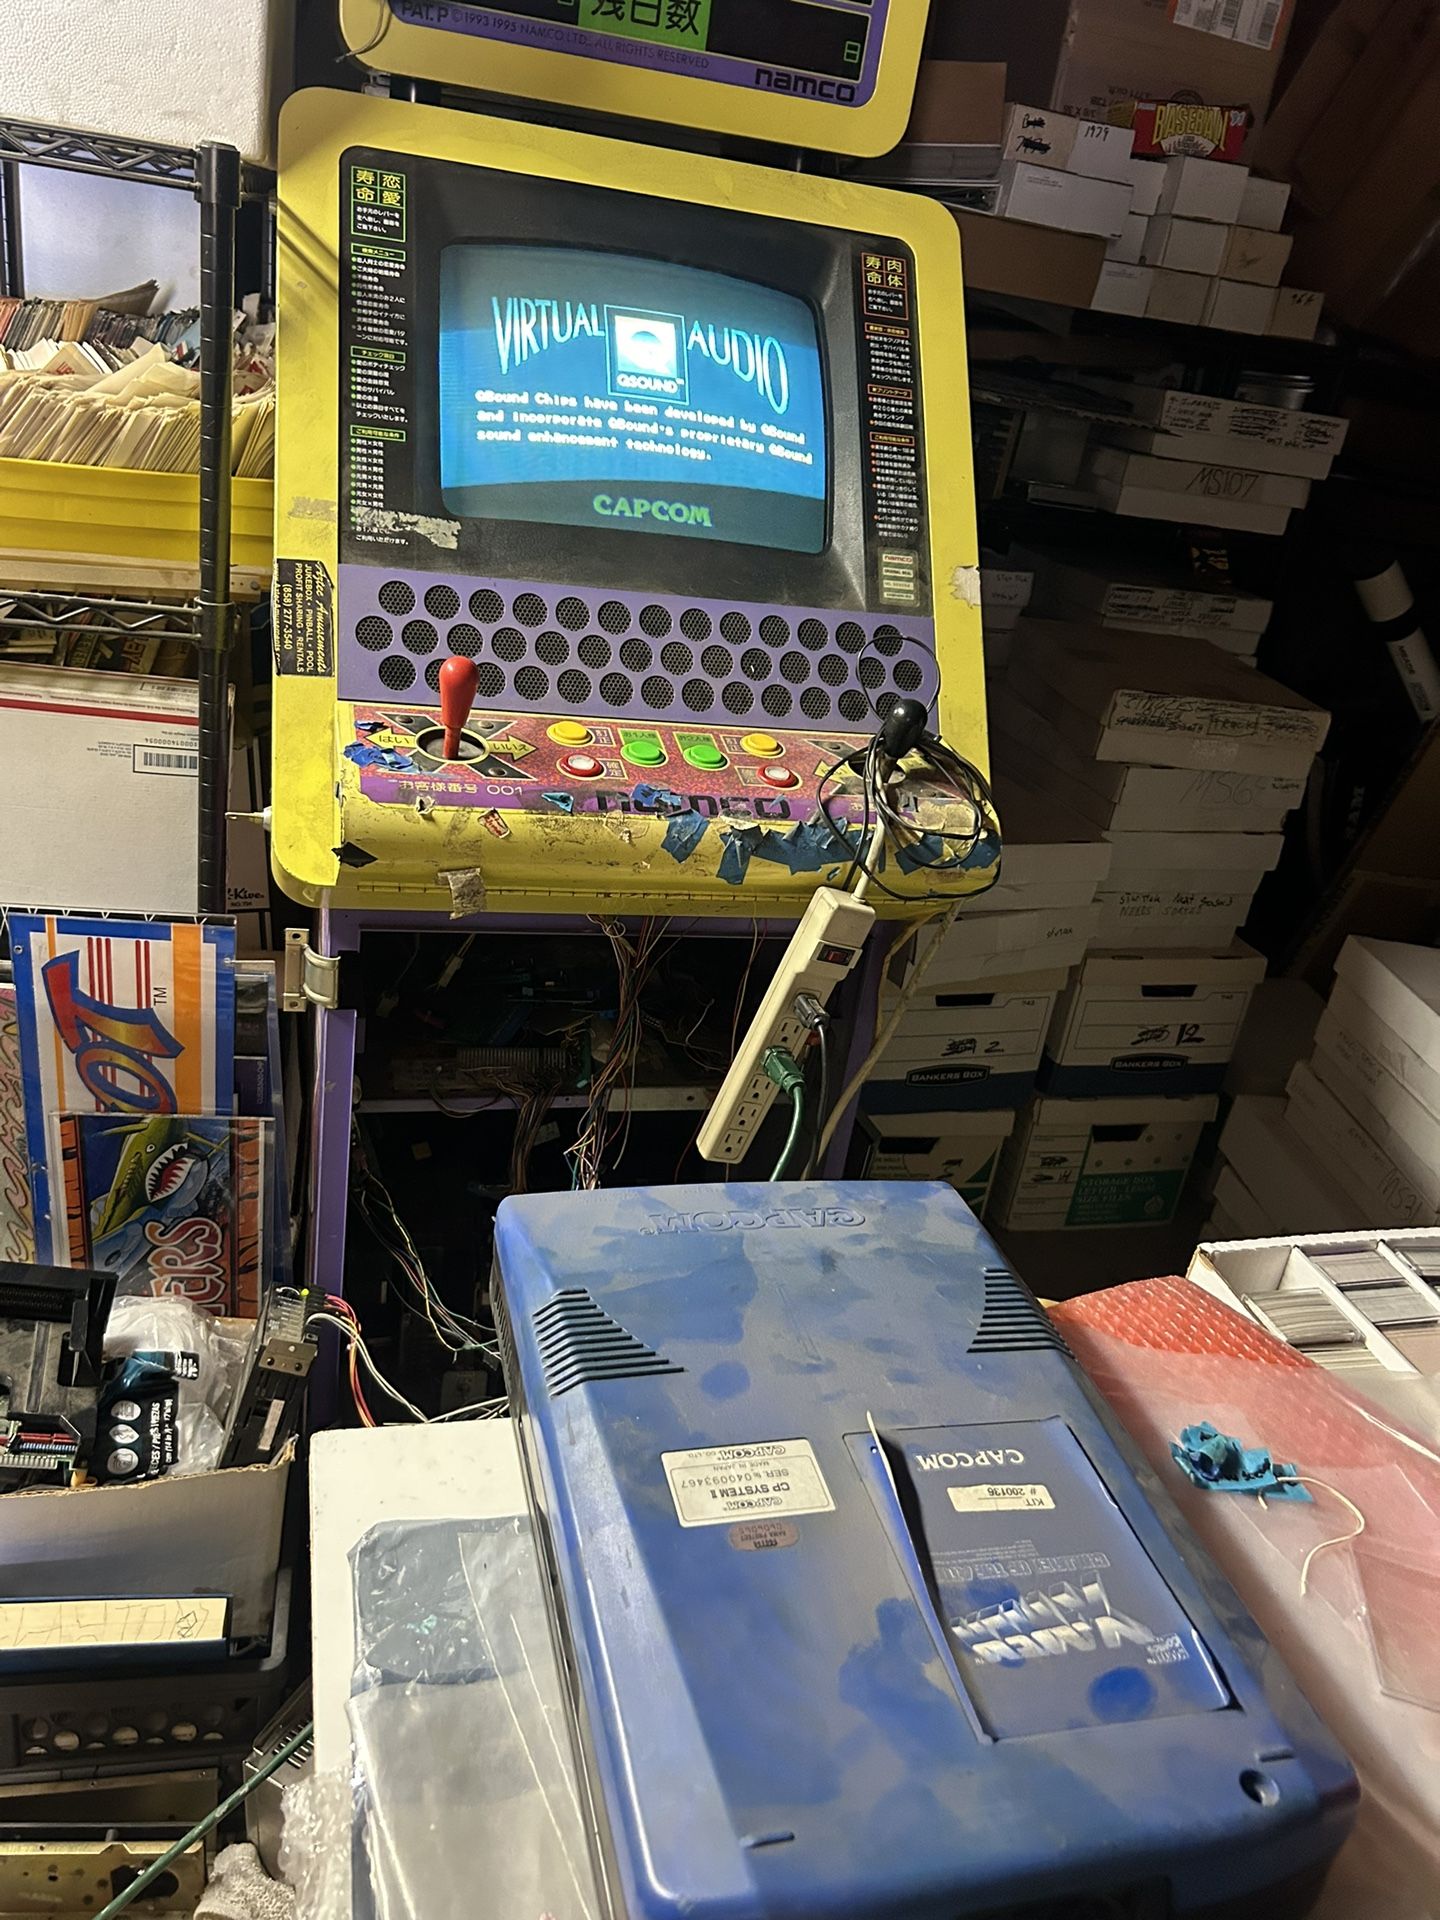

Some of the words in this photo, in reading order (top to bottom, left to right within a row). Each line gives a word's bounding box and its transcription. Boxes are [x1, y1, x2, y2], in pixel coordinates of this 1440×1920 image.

[492, 17, 517, 32] 1995
[613, 41, 655, 58] RIGHTS
[655, 49, 710, 69] RESERVED
[754, 67, 856, 102] namco
[491, 297, 606, 375] VIRTUAL
[687, 321, 789, 414] AUDIO
[584, 396, 618, 412] have
[624, 400, 658, 416] been
[665, 403, 735, 428] developed
[740, 419, 757, 434] by
[476, 409, 504, 424] and
[513, 411, 602, 428] incorporate
[680, 425, 765, 454] proprietary
[476, 430, 521, 443] sound
[528, 431, 619, 450] enhancement
[625, 437, 713, 463] technology.
[593, 494, 713, 528] CAPCOM
[295, 562, 303, 591] PROFIT
[304, 564, 313, 601] JUKEBOX
[295, 592, 304, 629] SHARING
[283, 608, 293, 650] 277-3540
[305, 609, 314, 642] PINBALL
[315, 600, 329, 674] Amusements
[296, 637, 305, 673] RENTALS
[306, 650, 315, 672] POOL
[378, 733, 410, 745] はい
[492, 740, 529, 752] いいえ
[911, 1071, 962, 1083] BANKERS
[962, 1070, 985, 1080] BOX
[1114, 1058, 1159, 1069] BANKERS
[1160, 1058, 1183, 1069] BOX
[648, 1207, 866, 1235] CAPCOM
[145, 1217, 226, 1316] ERS
[717, 1444, 786, 1461] CAPCOM
[916, 1448, 1025, 1471] CAPCOM
[680, 1472, 753, 1489] 040093467
[712, 1463, 736, 1472] JAPAN
[763, 1467, 790, 1478] SER.
[719, 1483, 769, 1498] SYSTEM
[772, 1481, 791, 1492] CP
[987, 1486, 1026, 1497] 200136
[722, 1496, 783, 1512] CAPCOM
[1025, 1497, 1045, 1508] KIT
